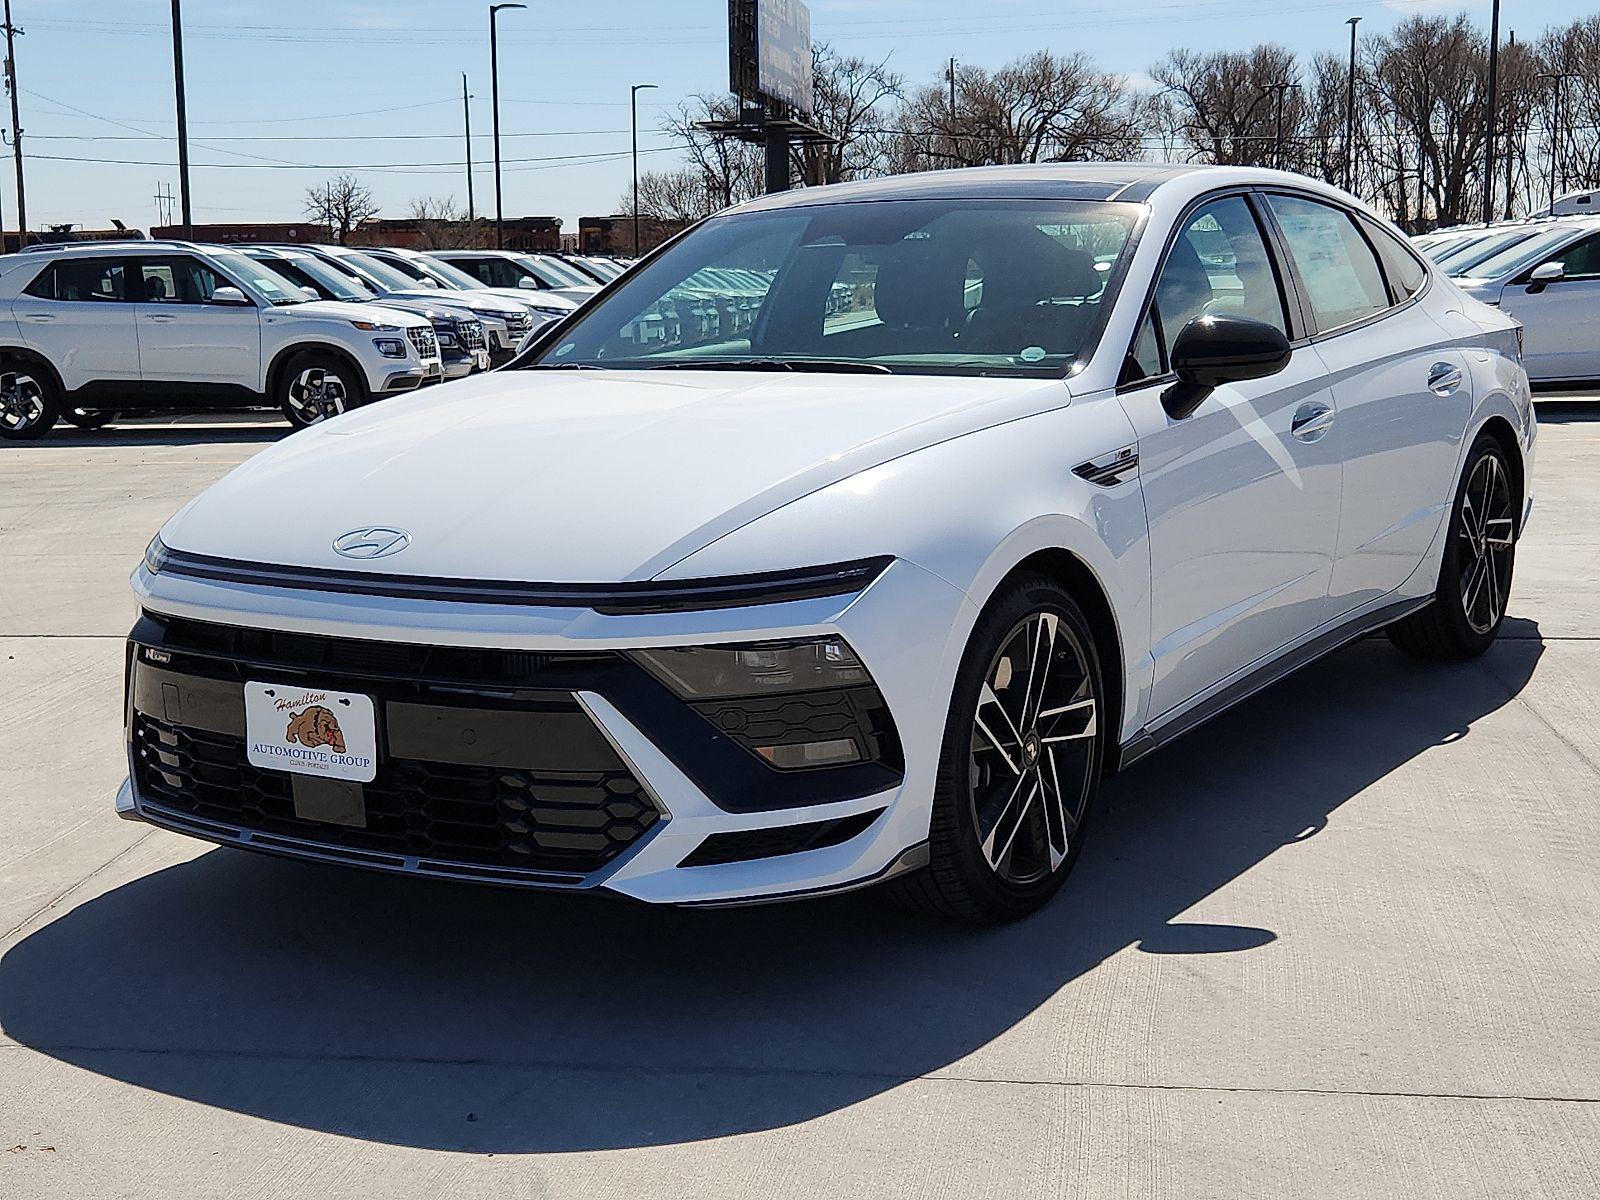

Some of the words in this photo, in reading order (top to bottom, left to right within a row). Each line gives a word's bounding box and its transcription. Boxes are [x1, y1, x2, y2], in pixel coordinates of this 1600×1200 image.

[274, 692, 327, 712] Hamilton
[253, 743, 327, 762] AUTOMOTIVE
[330, 754, 370, 768] GROUP
